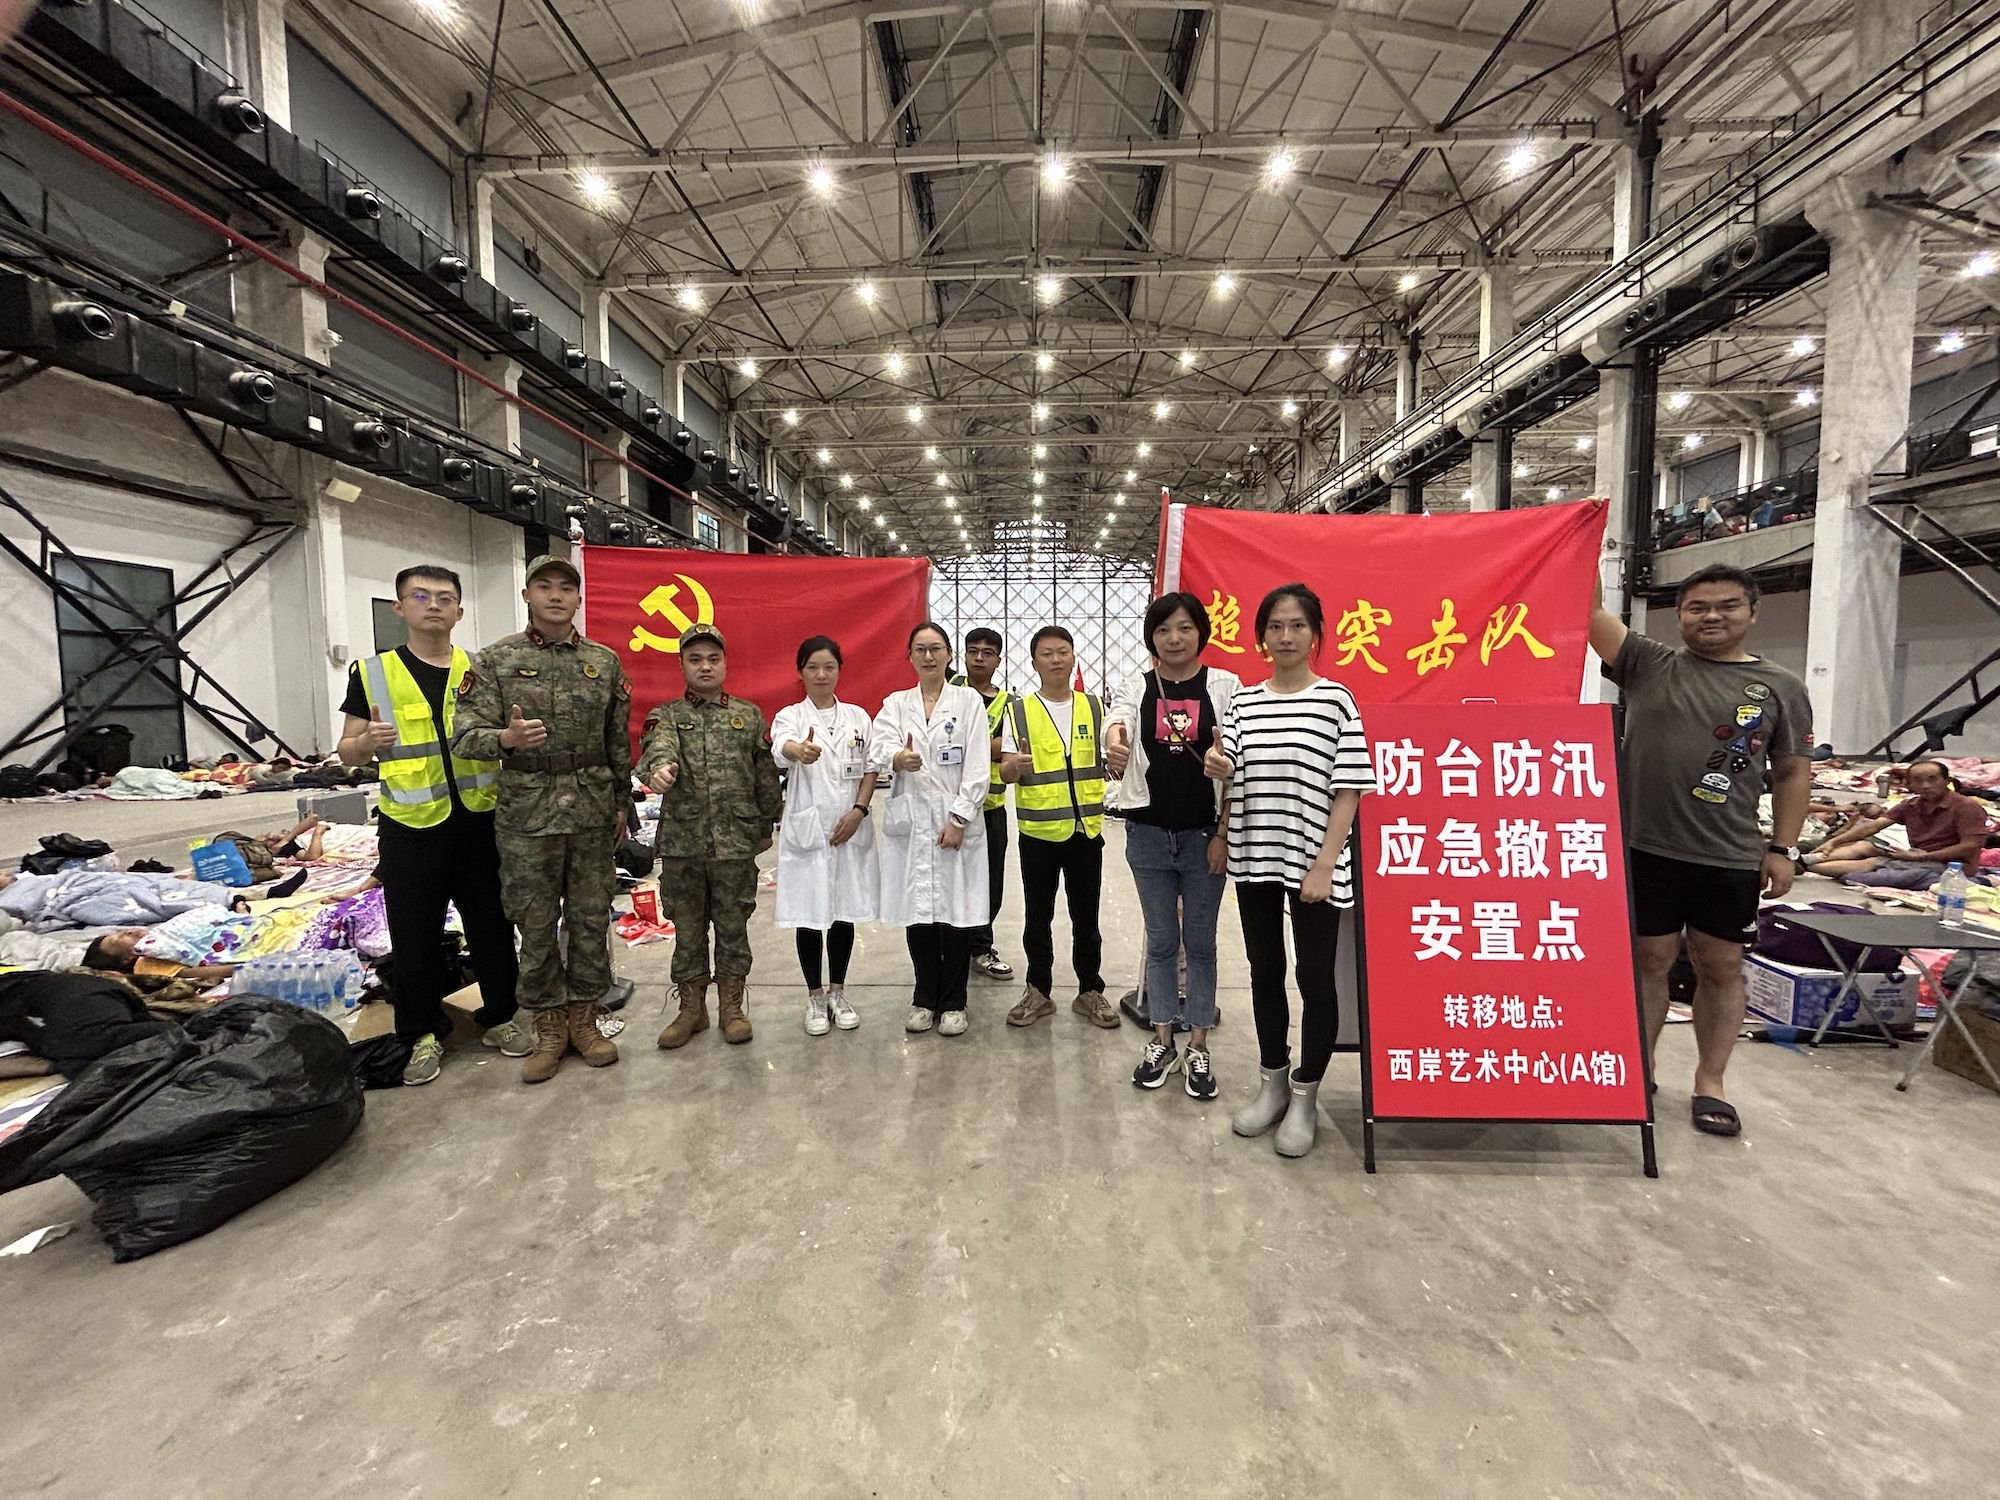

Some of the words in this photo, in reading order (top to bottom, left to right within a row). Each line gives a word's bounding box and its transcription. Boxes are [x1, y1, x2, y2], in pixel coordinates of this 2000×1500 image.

[1204, 590, 1556, 676] 超突击队
[1374, 738, 1606, 798] 防台防汛
[1376, 817, 1608, 880] 应急撤离
[1410, 900, 1586, 962] 安置点
[1443, 994, 1564, 1029] 转移地点:
[1387, 1047, 1626, 1086] 西岸艺术中心(A馆)
